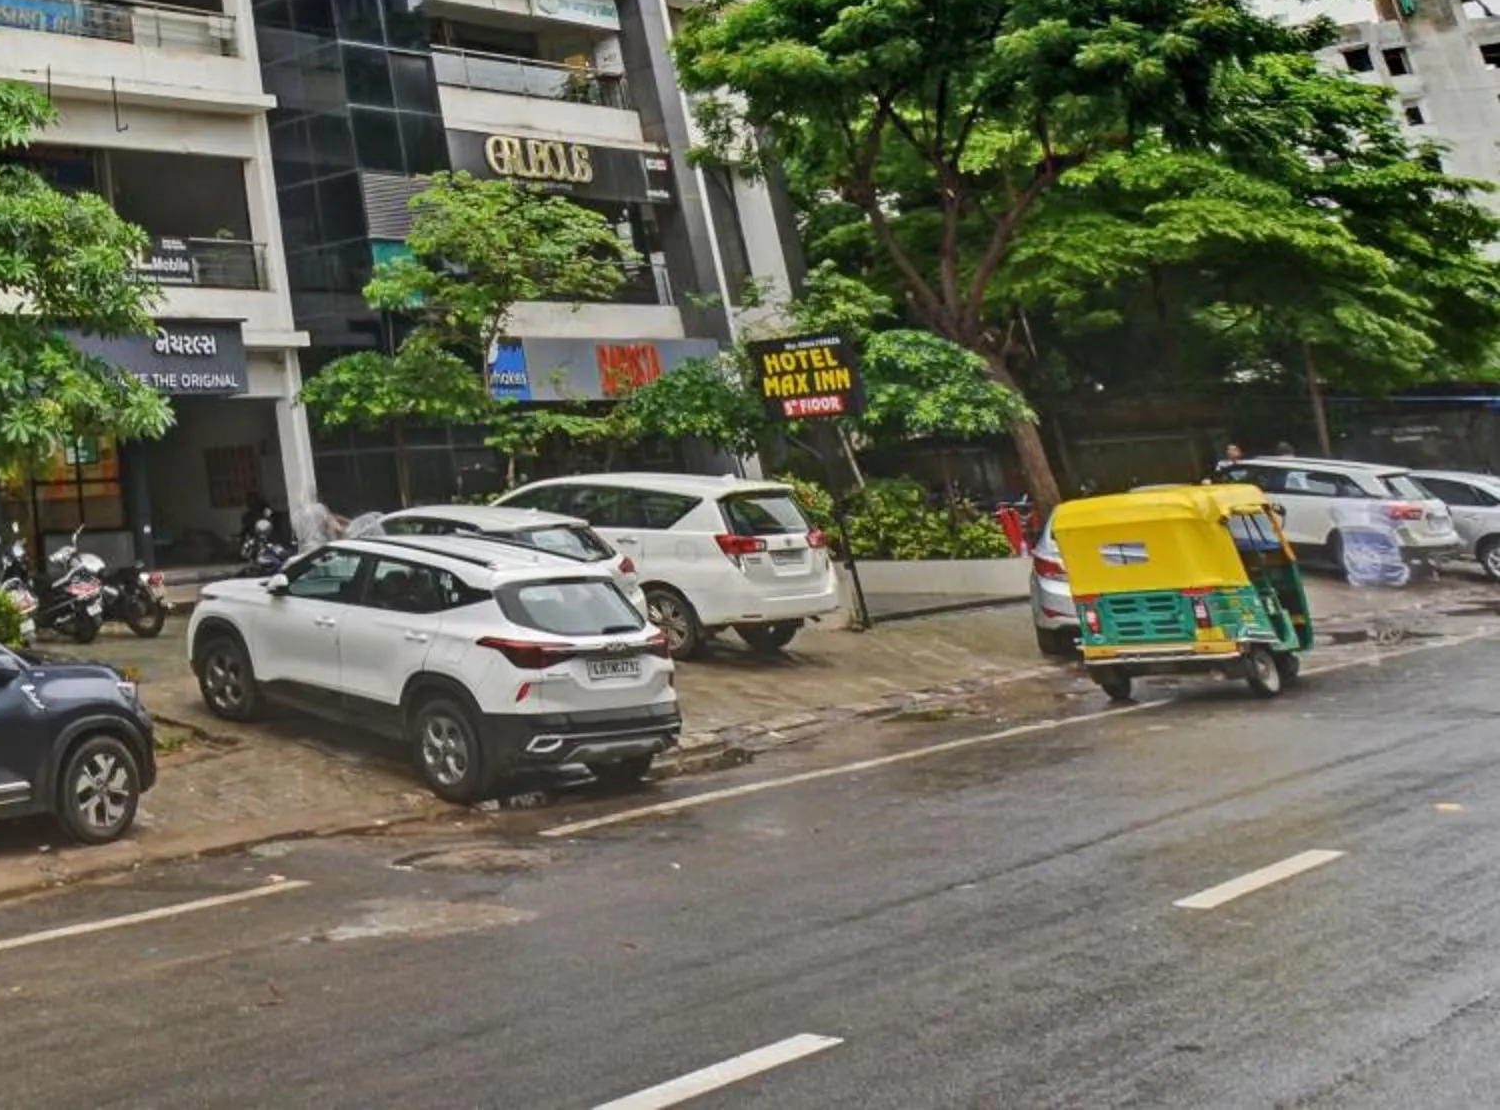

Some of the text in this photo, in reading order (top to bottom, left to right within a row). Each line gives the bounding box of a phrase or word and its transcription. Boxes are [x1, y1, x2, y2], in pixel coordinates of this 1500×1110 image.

[763, 347, 838, 374] HOTEL
[152, 373, 178, 387] THE
[181, 373, 240, 388] ORIGINAL
[763, 368, 852, 396] MAX INN
